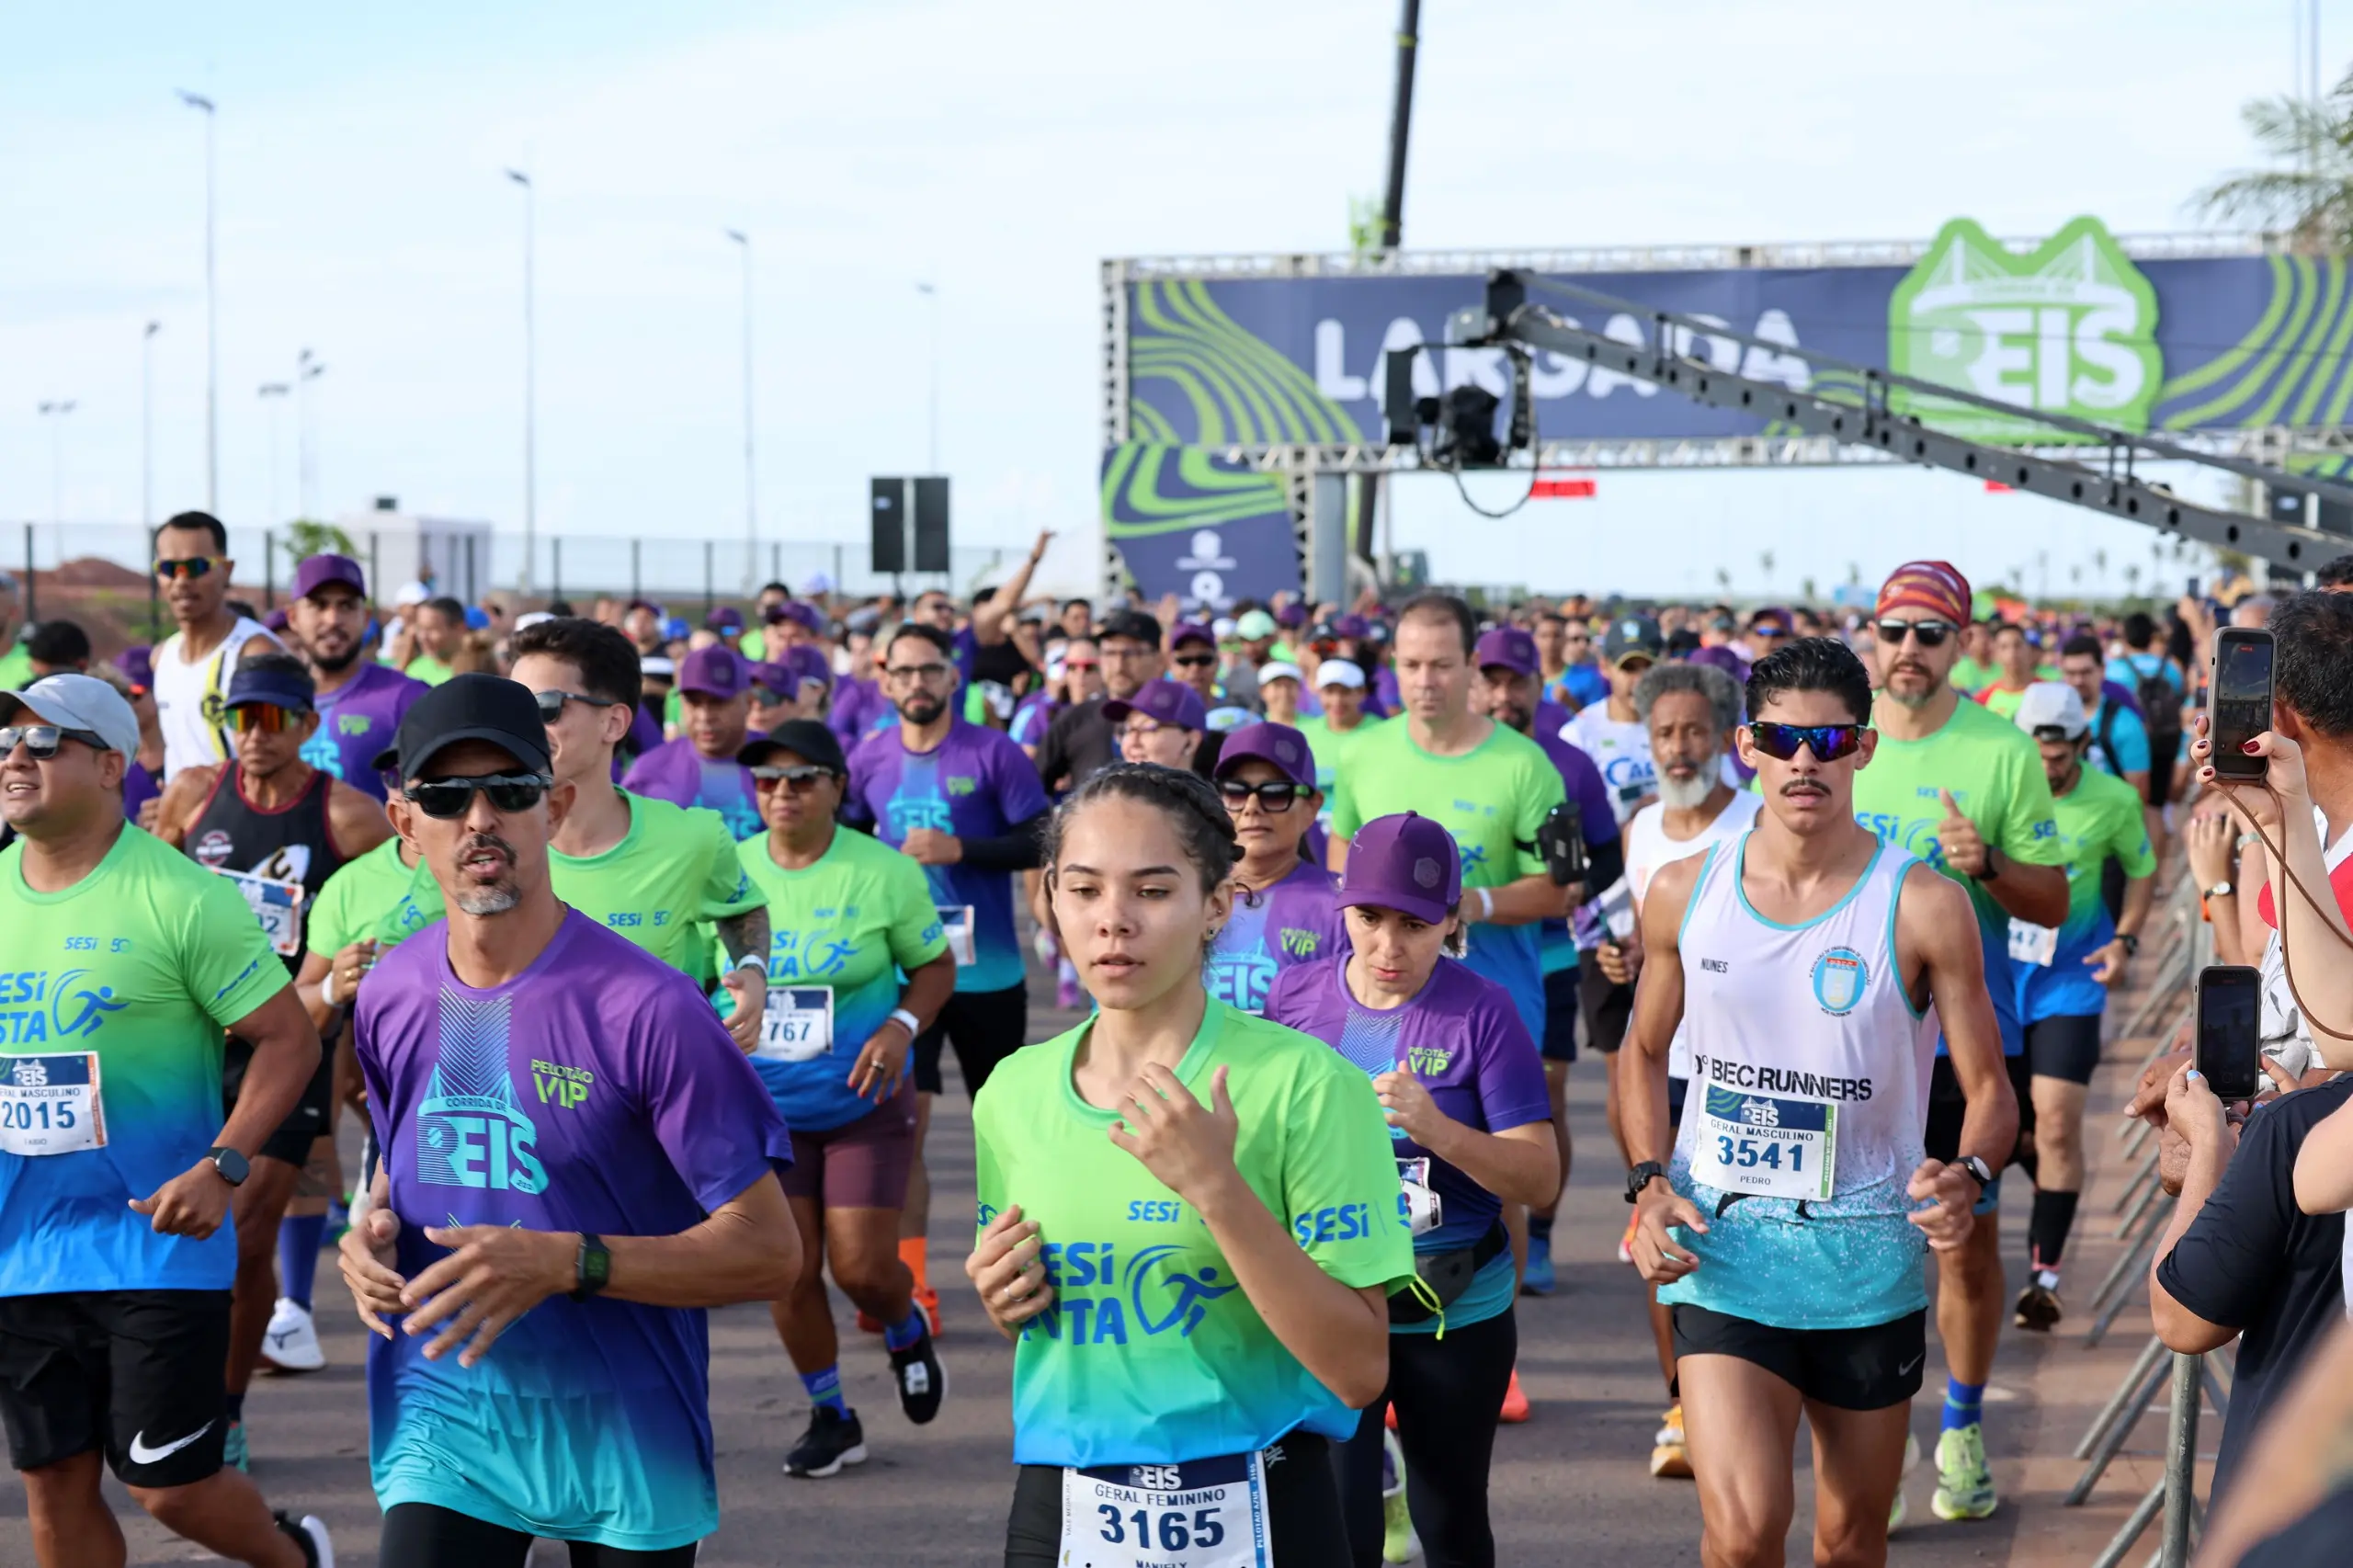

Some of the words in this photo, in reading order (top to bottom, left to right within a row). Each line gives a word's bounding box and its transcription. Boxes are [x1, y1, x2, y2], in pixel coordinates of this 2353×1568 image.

[1908, 308, 2145, 411] REIS
[608, 912, 642, 926] SESi
[64, 937, 100, 950] SESi
[1280, 934, 1317, 957] VIP
[1700, 957, 1729, 974] NUNES
[530, 1058, 595, 1084] PELOTÃO
[1409, 1055, 1449, 1077] VIP
[13, 1071, 49, 1087] REIS
[532, 1072, 589, 1109] VIP
[1711, 1058, 1755, 1087] BEC
[1757, 1066, 1873, 1102] RUNNERS
[20, 1087, 81, 1098] MASCULINO
[2, 1101, 75, 1131] 2015
[446, 1096, 494, 1110] CORRIDA
[495, 1101, 511, 1113] DE
[1740, 1106, 1779, 1127] REIS
[1711, 1119, 1742, 1135] GERAL
[1746, 1128, 1814, 1142] MASCULINO
[416, 1114, 550, 1195] REIS
[1717, 1135, 1803, 1172] 3541
[1740, 1175, 1771, 1186] PEDRO
[1128, 1200, 1180, 1222] SESi
[1294, 1203, 1370, 1248] SESi
[1040, 1243, 1113, 1286] ESi
[1129, 1464, 1182, 1490] REIS
[1249, 1463, 1257, 1482] 3165
[1095, 1483, 1141, 1504] GERAL
[1148, 1489, 1226, 1506] FEMININO
[1251, 1490, 1260, 1510] AZUL
[1097, 1504, 1225, 1551] 3165
